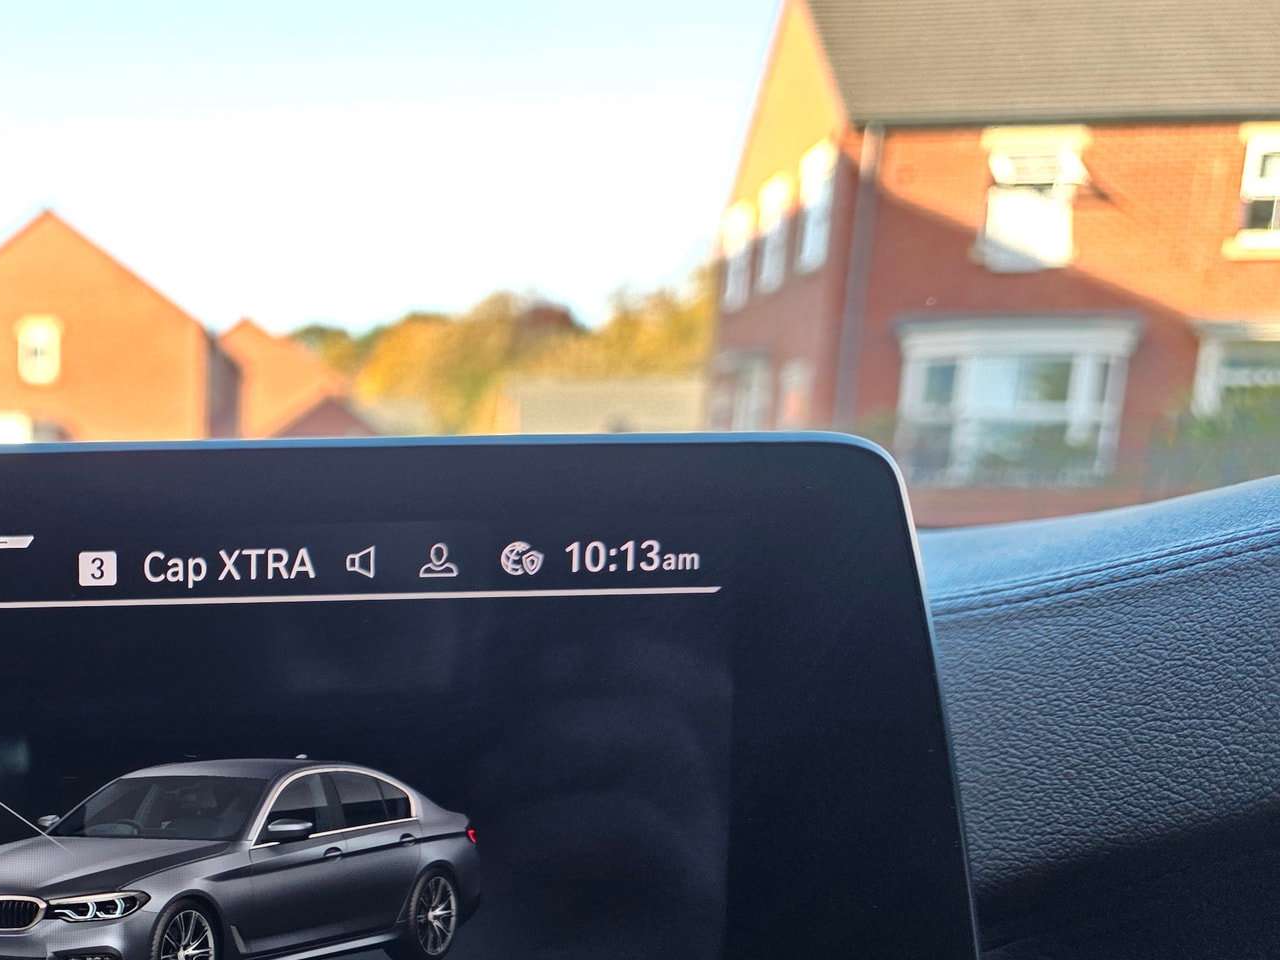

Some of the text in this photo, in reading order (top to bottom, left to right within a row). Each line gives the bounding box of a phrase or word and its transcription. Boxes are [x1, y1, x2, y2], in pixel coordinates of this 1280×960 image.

[90, 547, 316, 589] 3 Cap XTRA
[565, 539, 700, 573] 10:13am
